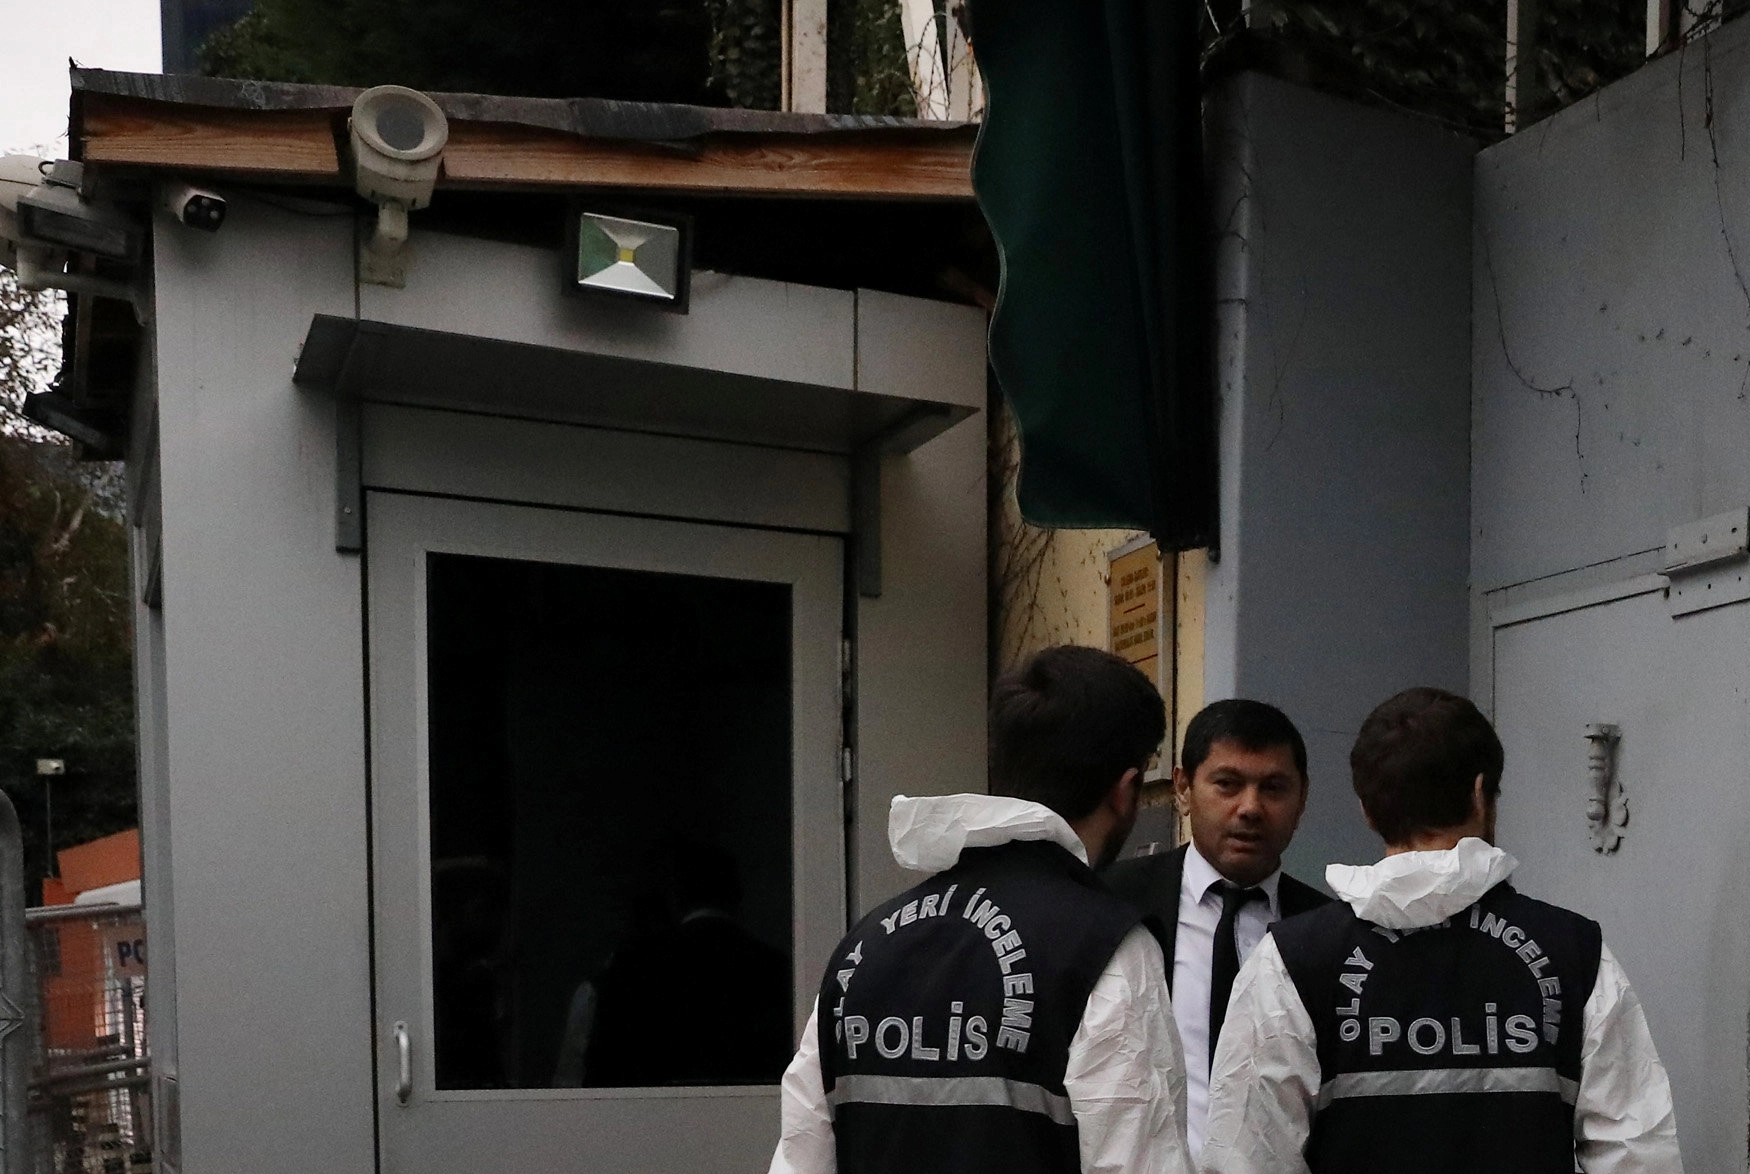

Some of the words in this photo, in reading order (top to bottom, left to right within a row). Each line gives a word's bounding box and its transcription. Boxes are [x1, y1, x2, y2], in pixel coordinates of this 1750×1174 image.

[880, 884, 959, 935] YERİ
[962, 887, 1035, 1054] İNCELEME
[1335, 946, 1375, 1042] OLAY
[844, 1001, 989, 1061] POLİS
[1368, 1002, 1539, 1056] POLİS
